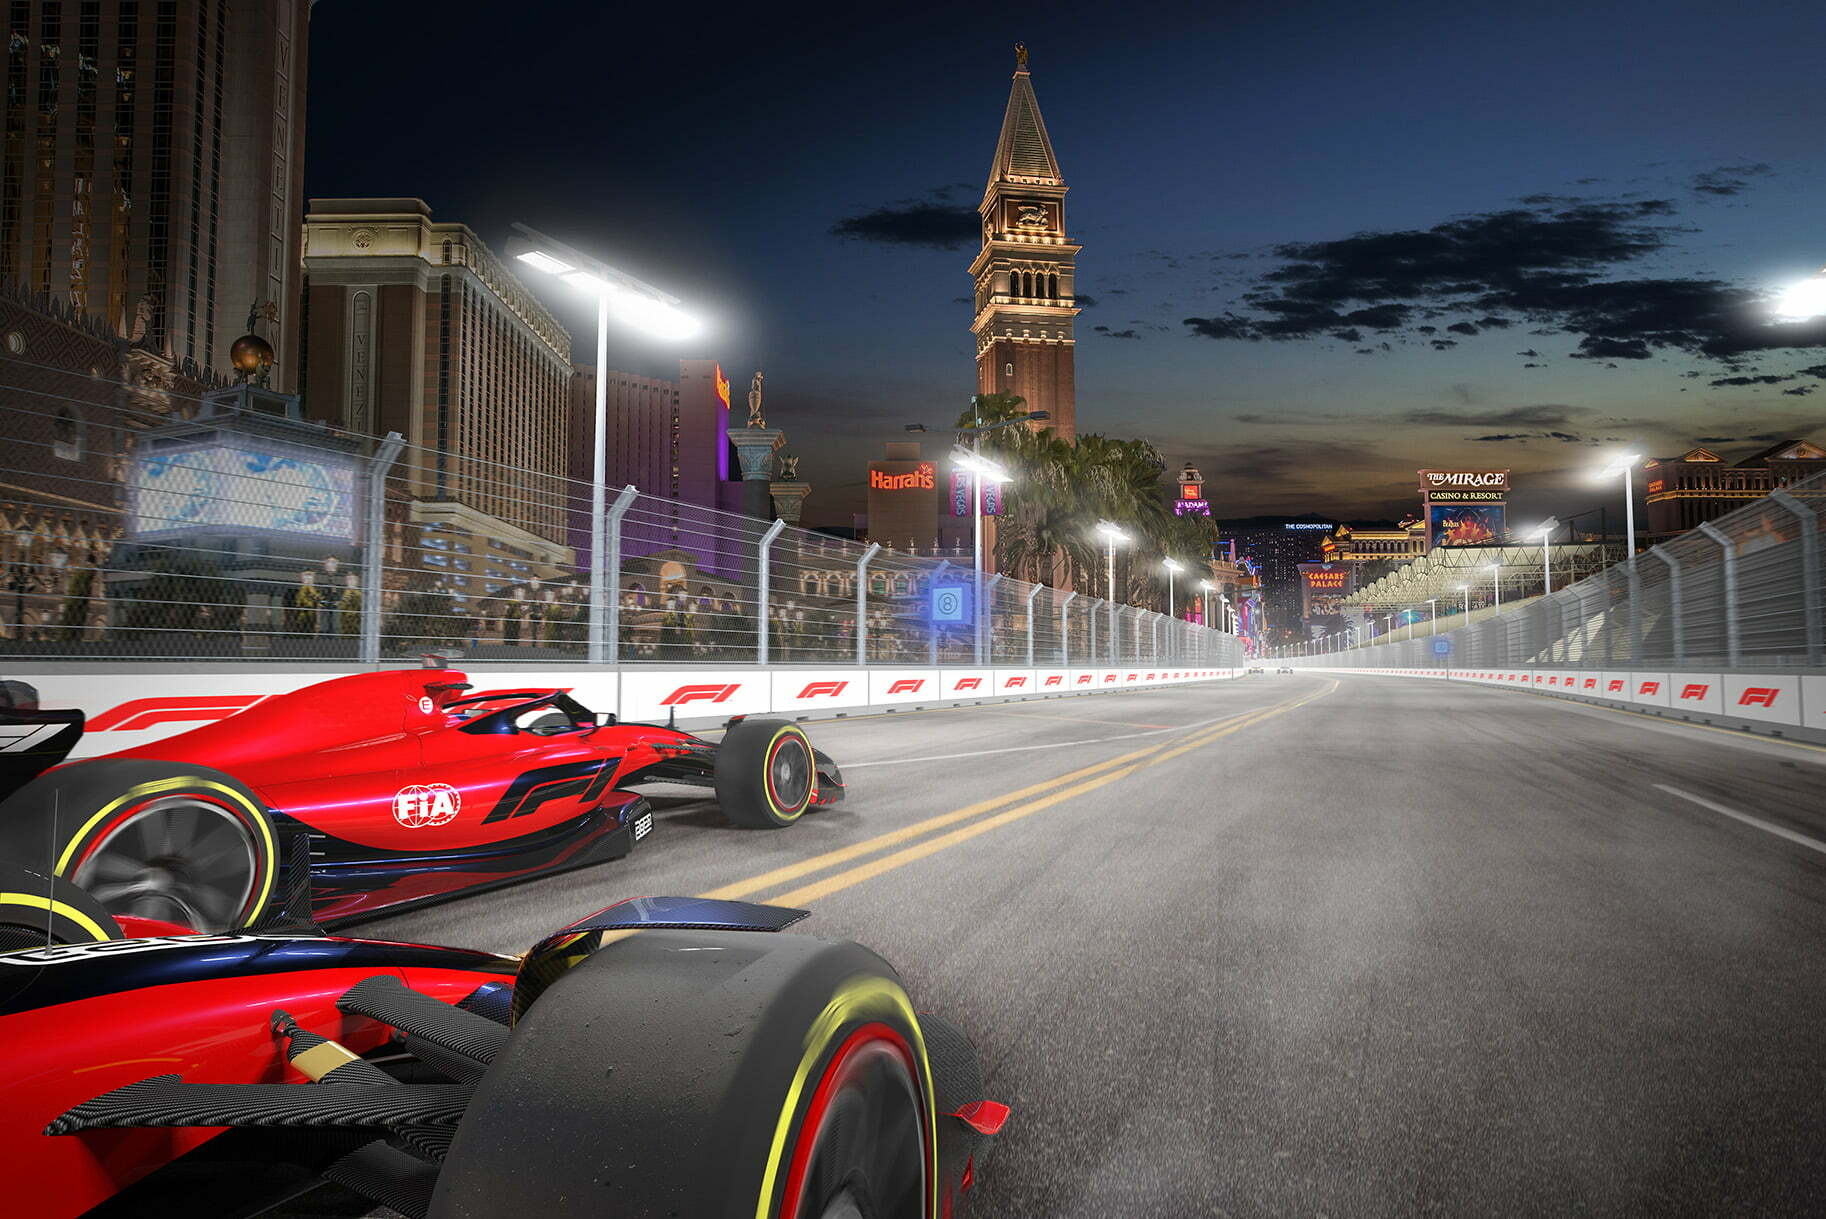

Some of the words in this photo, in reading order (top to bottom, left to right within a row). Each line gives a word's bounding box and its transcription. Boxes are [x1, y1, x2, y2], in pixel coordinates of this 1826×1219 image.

[355, 334, 366, 433] VENEZI
[1427, 472, 1444, 481] THE
[1432, 473, 1505, 487] MIRAGE
[956, 489, 967, 516] VEGAS
[1430, 492, 1461, 500] CASINO
[1462, 492, 1469, 500] &
[1470, 492, 1504, 500] RESORT
[1311, 580, 1343, 588] PALACE
[659, 683, 742, 705] F1
[796, 680, 848, 699] F1
[1737, 687, 1781, 708] F1
[480, 756, 625, 825] F1
